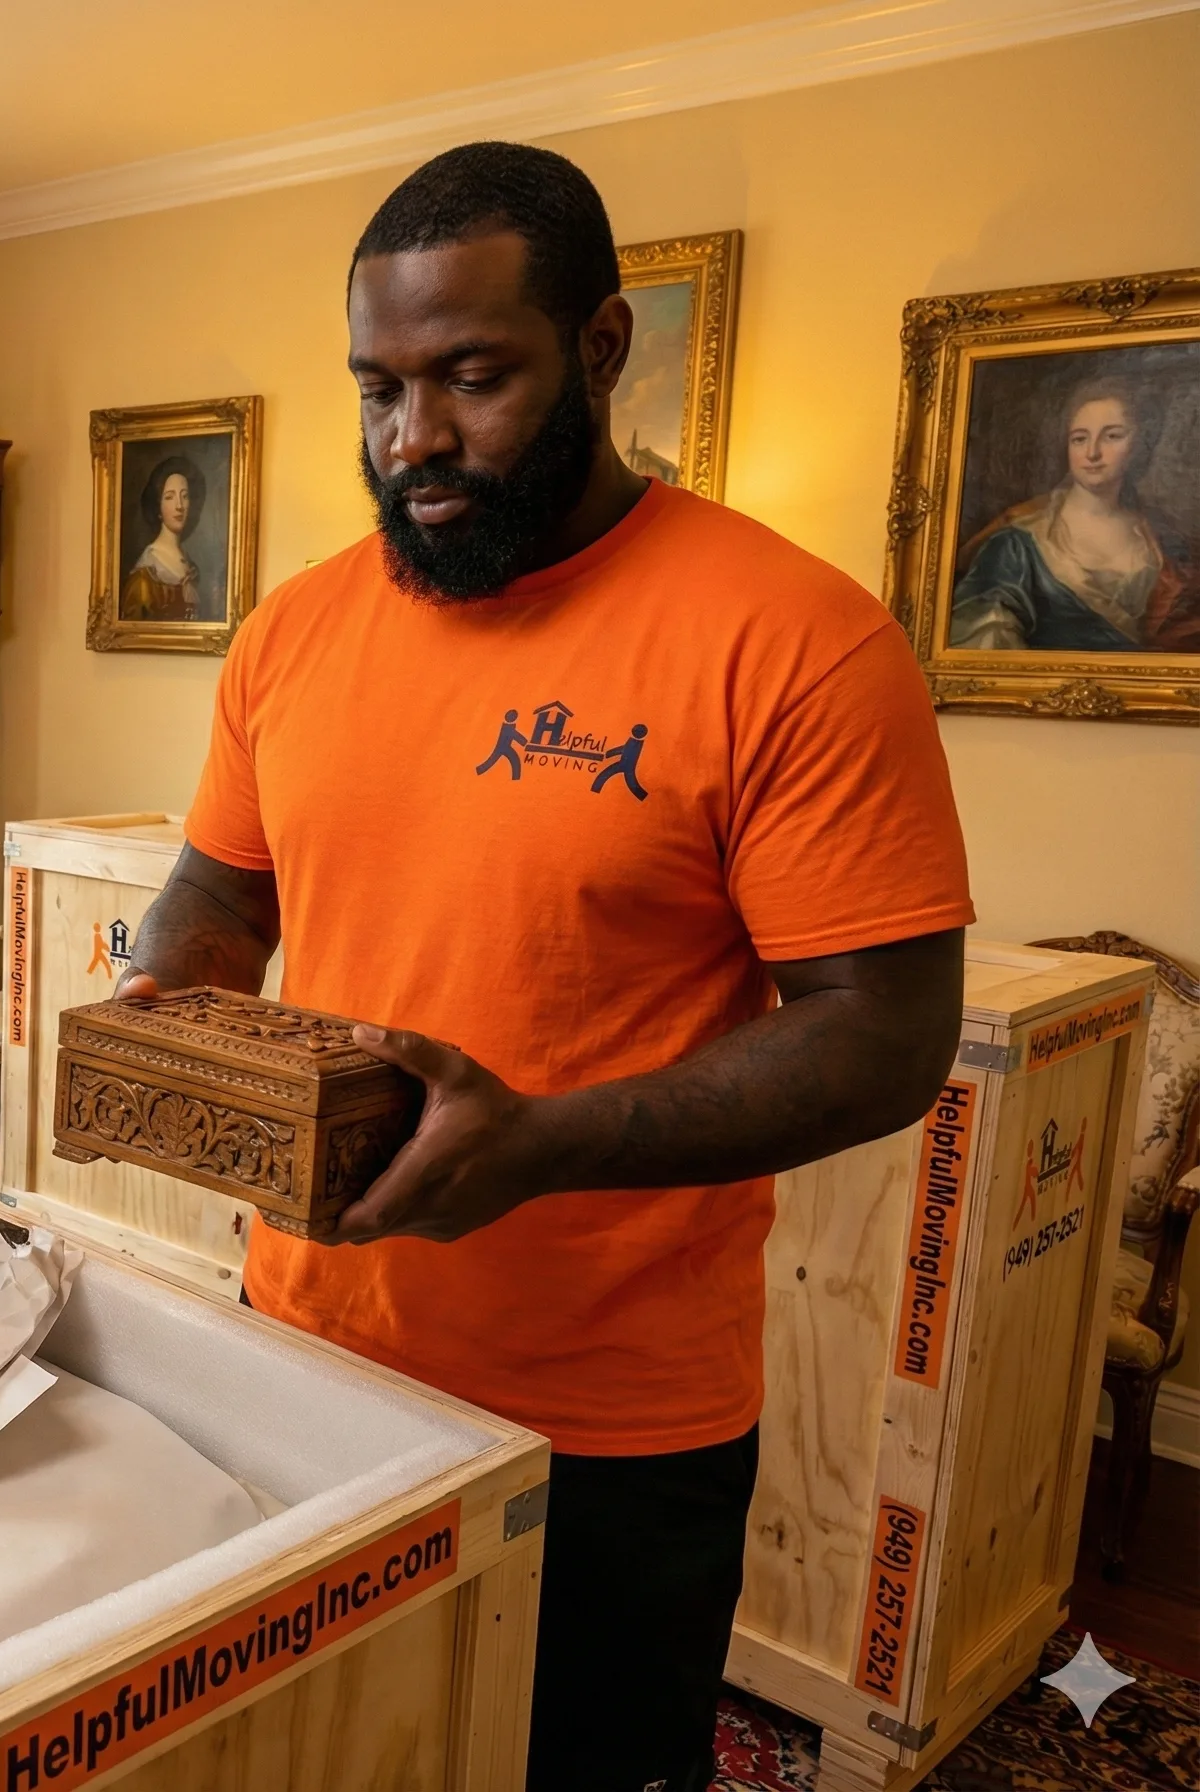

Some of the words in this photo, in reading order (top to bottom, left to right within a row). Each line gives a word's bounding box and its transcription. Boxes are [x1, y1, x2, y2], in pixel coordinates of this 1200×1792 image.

[524, 753, 599, 773] MOVING
[530, 711, 608, 752] Helpful
[903, 1085, 969, 1375] HelpfulMovingInc.com
[1003, 1235, 1034, 1284] (949)
[1034, 1204, 1085, 1258] 257-2521
[874, 1504, 918, 1572] (949)
[7, 1526, 452, 1792] HelpfulMovingInc.com
[865, 1573, 907, 1695] 257-2521
